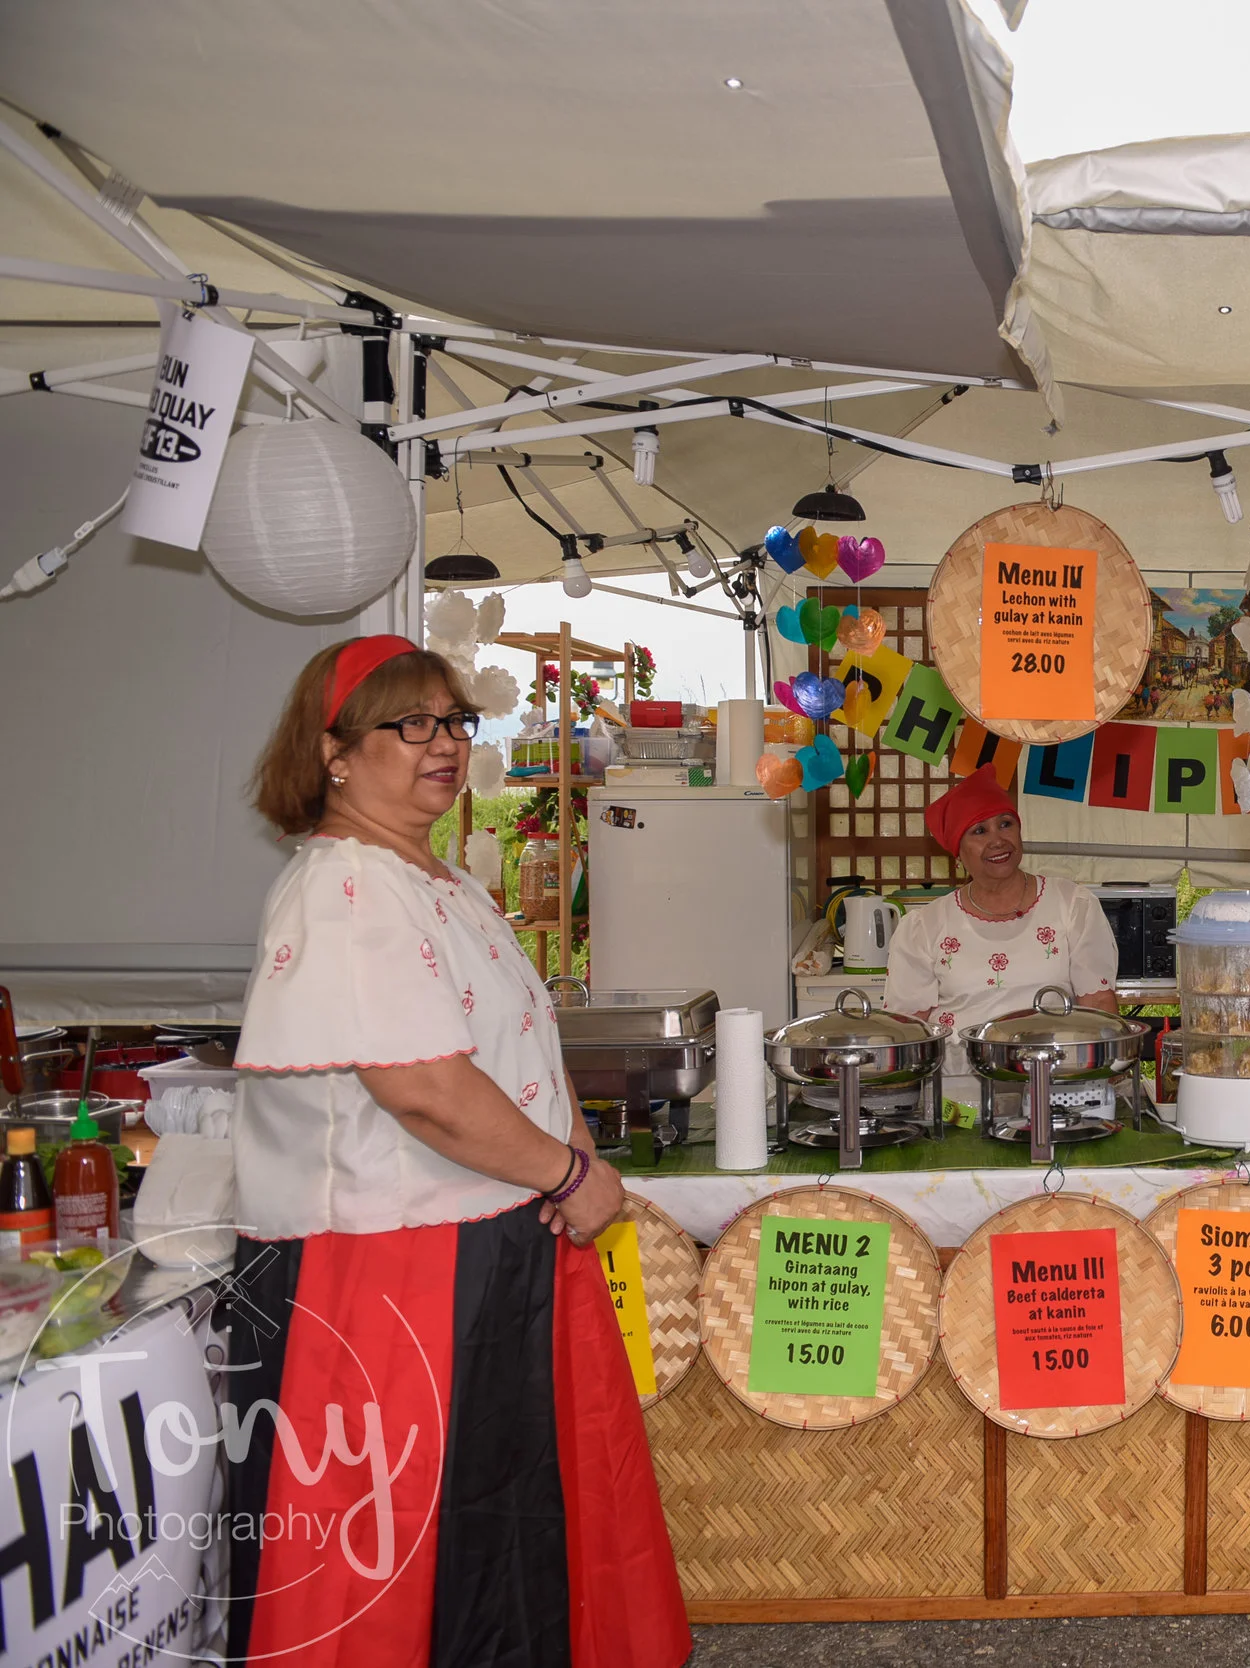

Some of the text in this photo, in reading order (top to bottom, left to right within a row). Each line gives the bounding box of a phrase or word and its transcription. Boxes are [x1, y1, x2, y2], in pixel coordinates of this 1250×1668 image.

[160, 354, 189, 388] BUN
[158, 391, 215, 430] QUAY
[998, 560, 1057, 588] Menu
[1002, 590, 1076, 608] Lechon with
[994, 609, 1083, 625] gulay at kanin
[1011, 652, 1065, 674] 28.00
[775, 1230, 871, 1258] MENU 2
[785, 1260, 858, 1279] Ginataang
[1012, 1260, 1077, 1284] Menu
[1208, 1253, 1222, 1277] 3
[769, 1276, 871, 1297] hipon at gulay,
[1007, 1287, 1105, 1304] Beef caldereta
[1193, 1285, 1228, 1296] raviolis
[1230, 1287, 1235, 1296] à
[1238, 1287, 1246, 1296] la
[788, 1296, 849, 1312] with rice
[1028, 1305, 1086, 1321] at kanin
[1200, 1298, 1219, 1307] cuit
[1221, 1298, 1226, 1307] à
[1229, 1298, 1237, 1308] la
[787, 1343, 844, 1365] 15.00
[1032, 1348, 1089, 1371] 15.00
